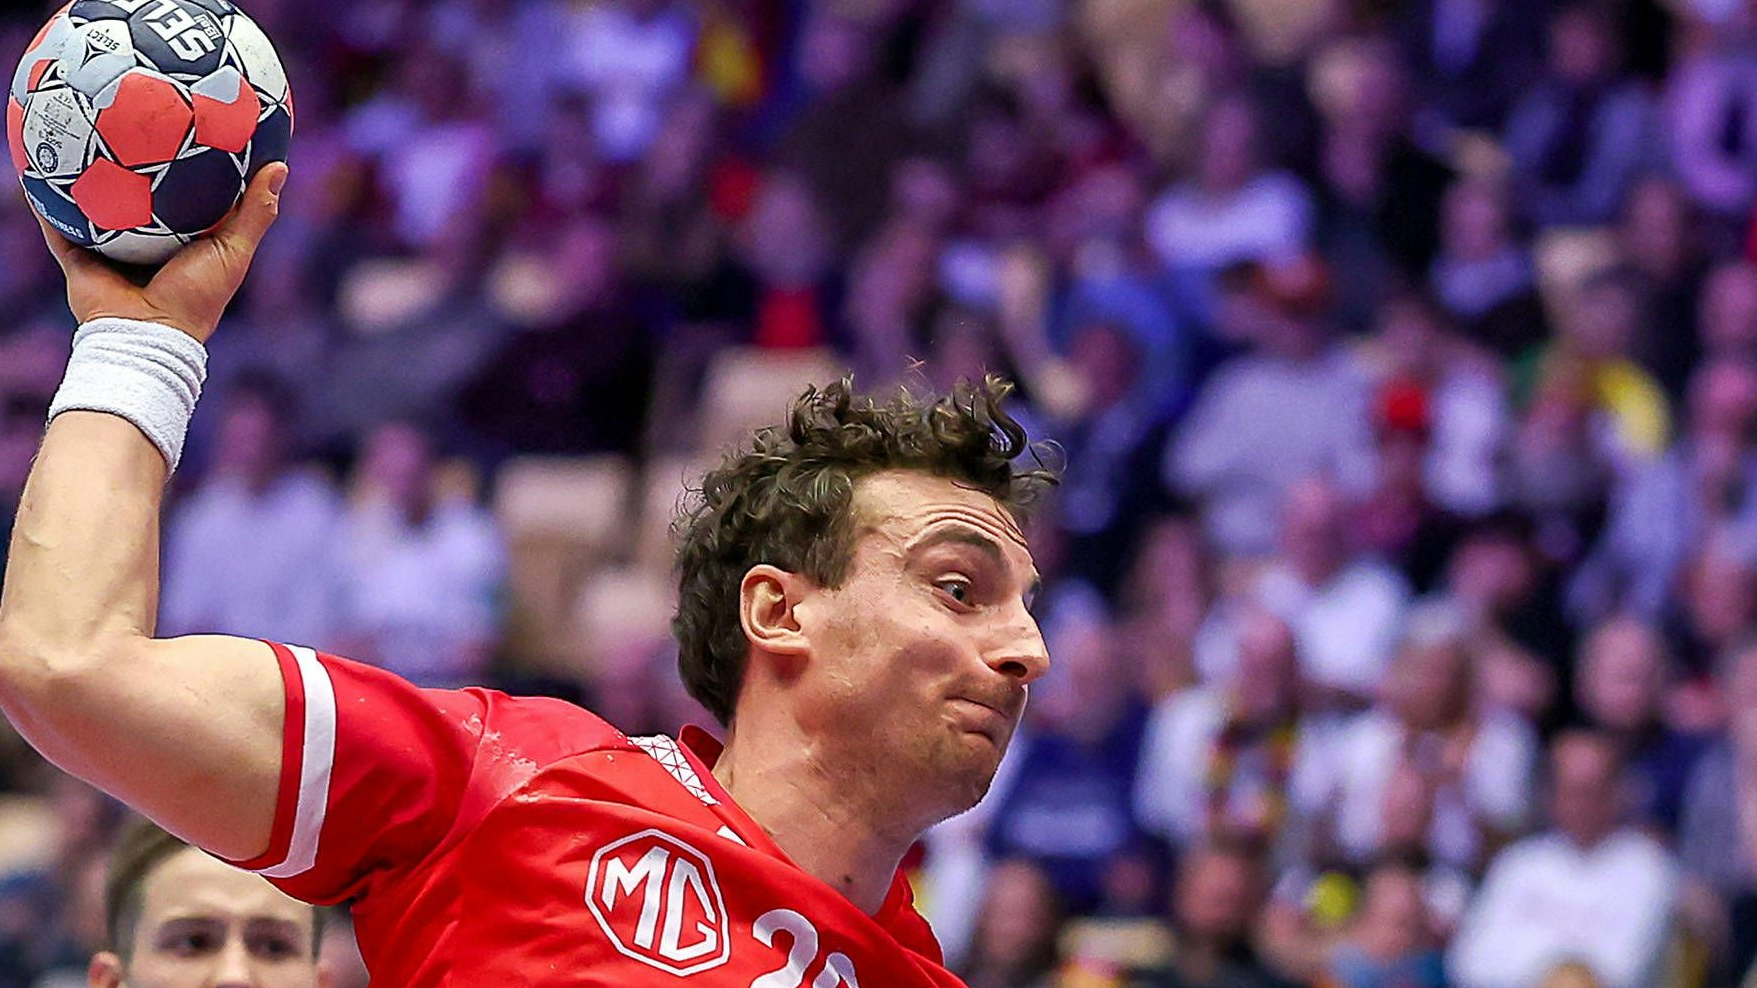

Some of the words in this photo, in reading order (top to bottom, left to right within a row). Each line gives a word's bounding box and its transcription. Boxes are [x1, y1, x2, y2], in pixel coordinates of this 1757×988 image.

[87, 29, 120, 51] SELECT
[111, 0, 217, 62] SEL
[601, 845, 718, 962] MG
